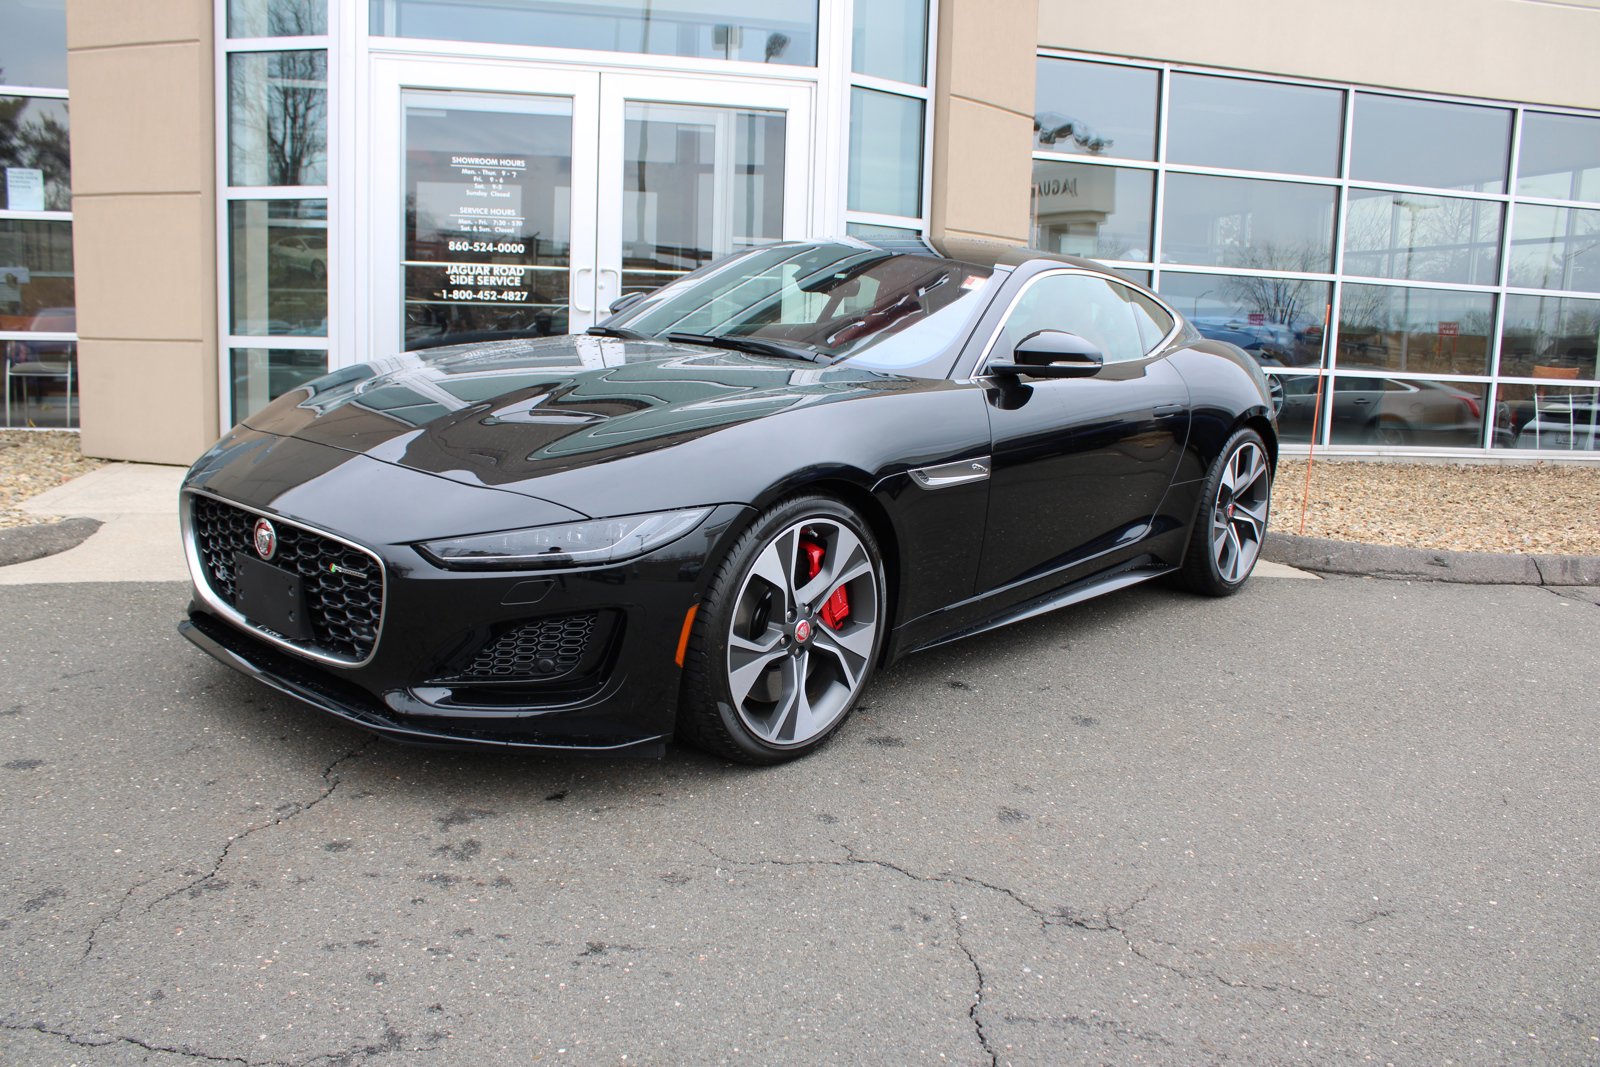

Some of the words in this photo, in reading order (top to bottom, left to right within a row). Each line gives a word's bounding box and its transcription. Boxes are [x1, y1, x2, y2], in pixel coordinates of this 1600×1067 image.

[451, 156, 499, 166] SHOWROOM
[499, 159, 526, 167] HOURS
[459, 207, 489, 215] SERVICE
[490, 208, 516, 216] HOURS
[448, 241, 525, 254] 860-524-0000
[445, 265, 490, 275] JAGUAR
[493, 267, 525, 276] ROAD
[449, 275, 475, 285] SIDE
[477, 276, 521, 286] SERVICE
[441, 289, 529, 301] 1-800-452-4827
